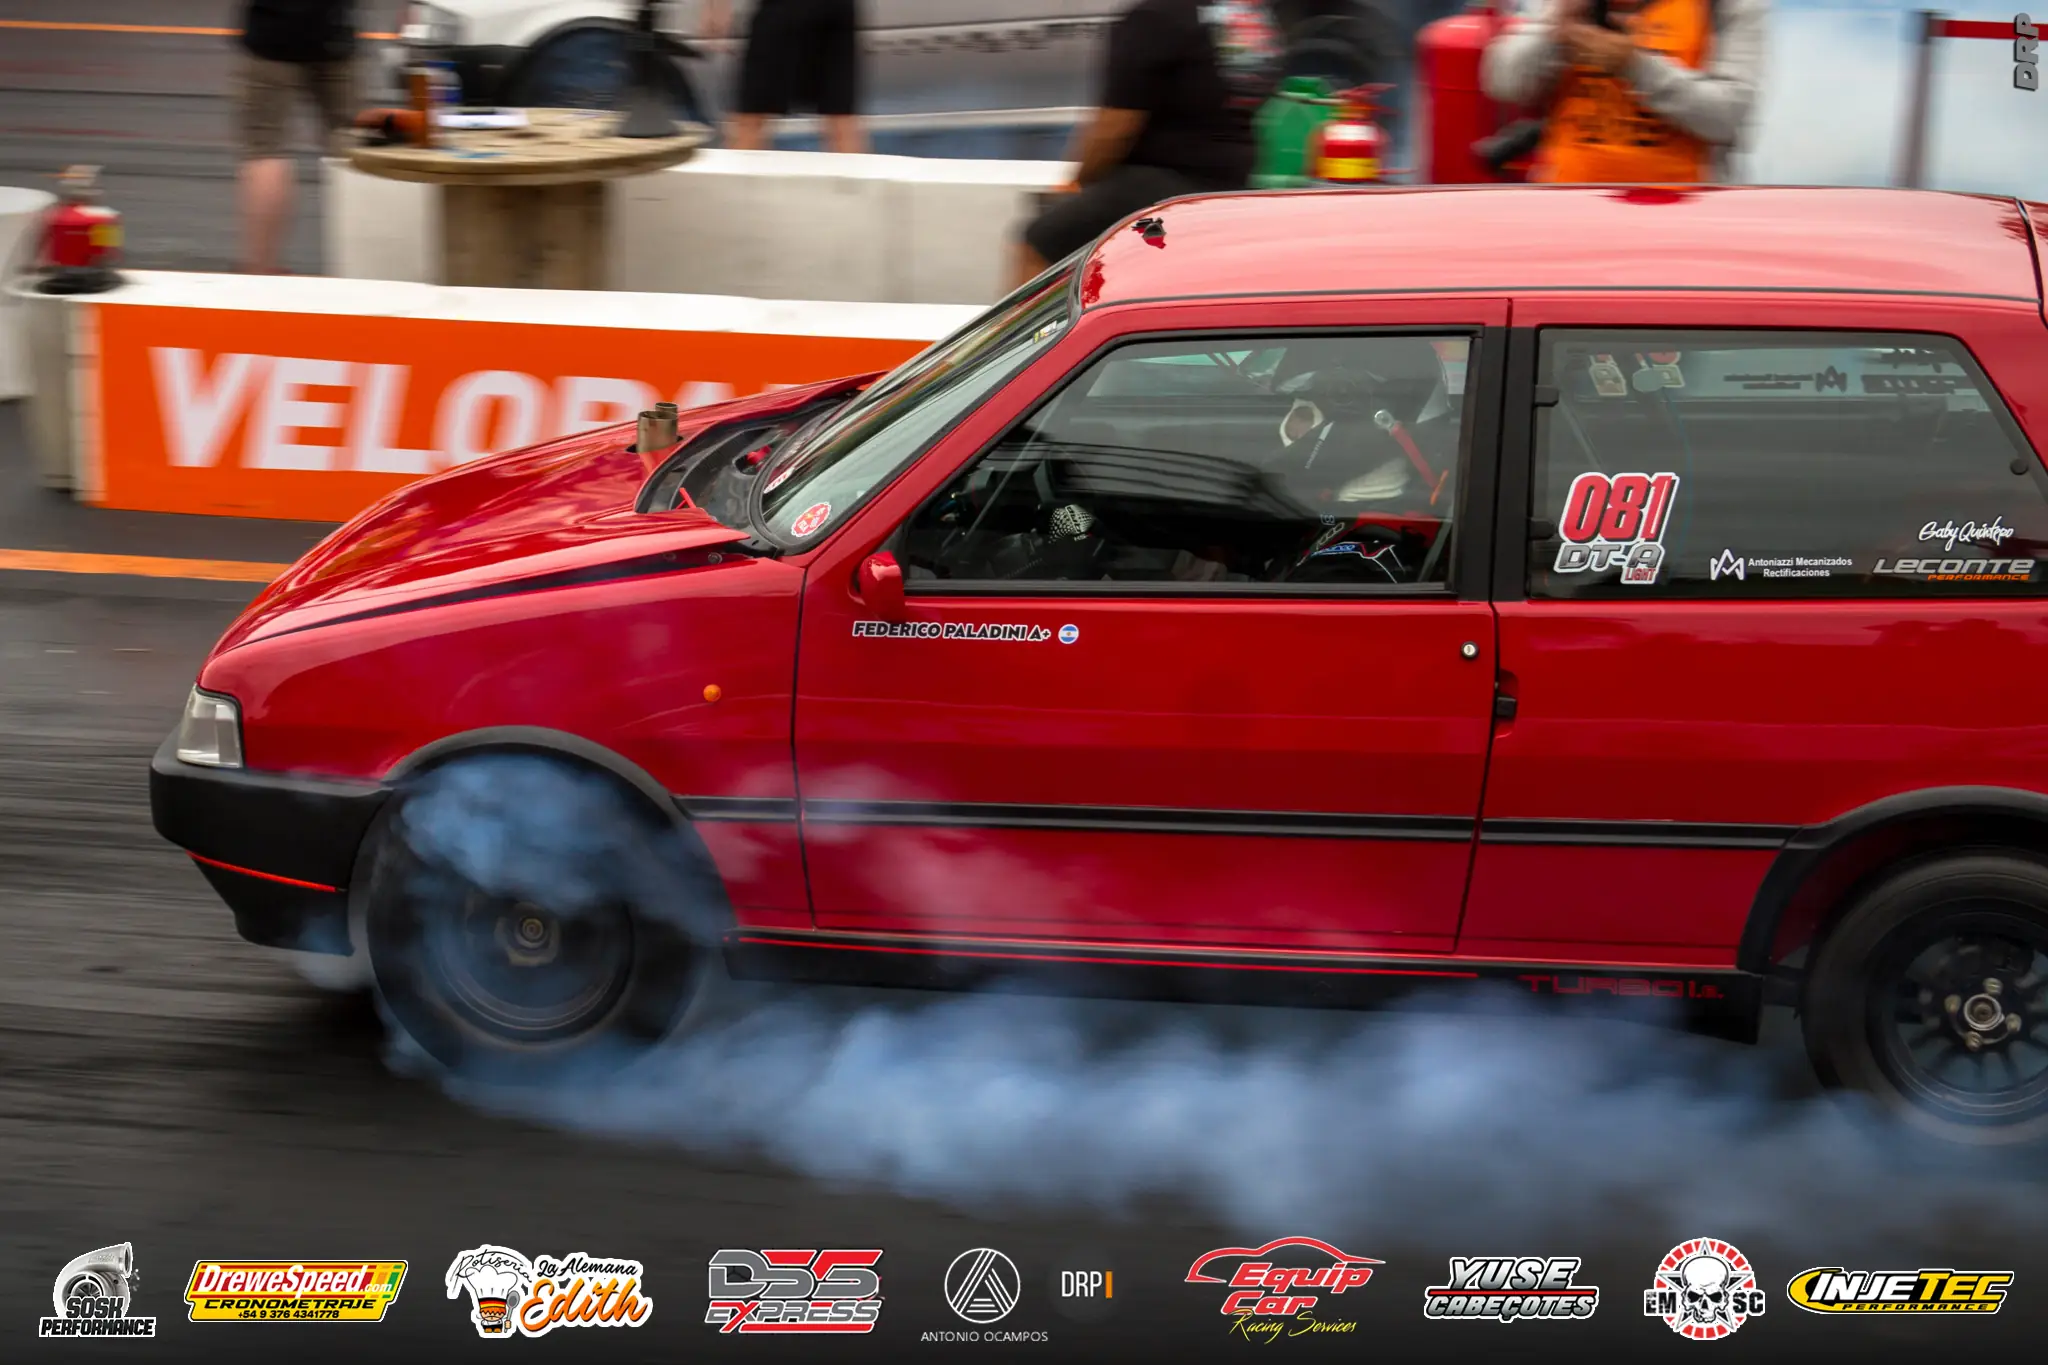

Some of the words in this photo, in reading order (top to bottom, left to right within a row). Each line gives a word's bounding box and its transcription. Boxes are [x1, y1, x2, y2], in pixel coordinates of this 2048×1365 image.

[1562, 474, 1677, 543] 081
[1558, 543, 1662, 569] DT-A
[1748, 557, 1794, 567] Antoniazzi
[1795, 556, 1853, 567] Mecanizados
[1763, 568, 1830, 578] Rectificaciones
[853, 621, 943, 638] FEDERICO
[944, 622, 1028, 641] PALADINI
[1027, 624, 1052, 642] A+
[1517, 974, 1685, 998] TURBO
